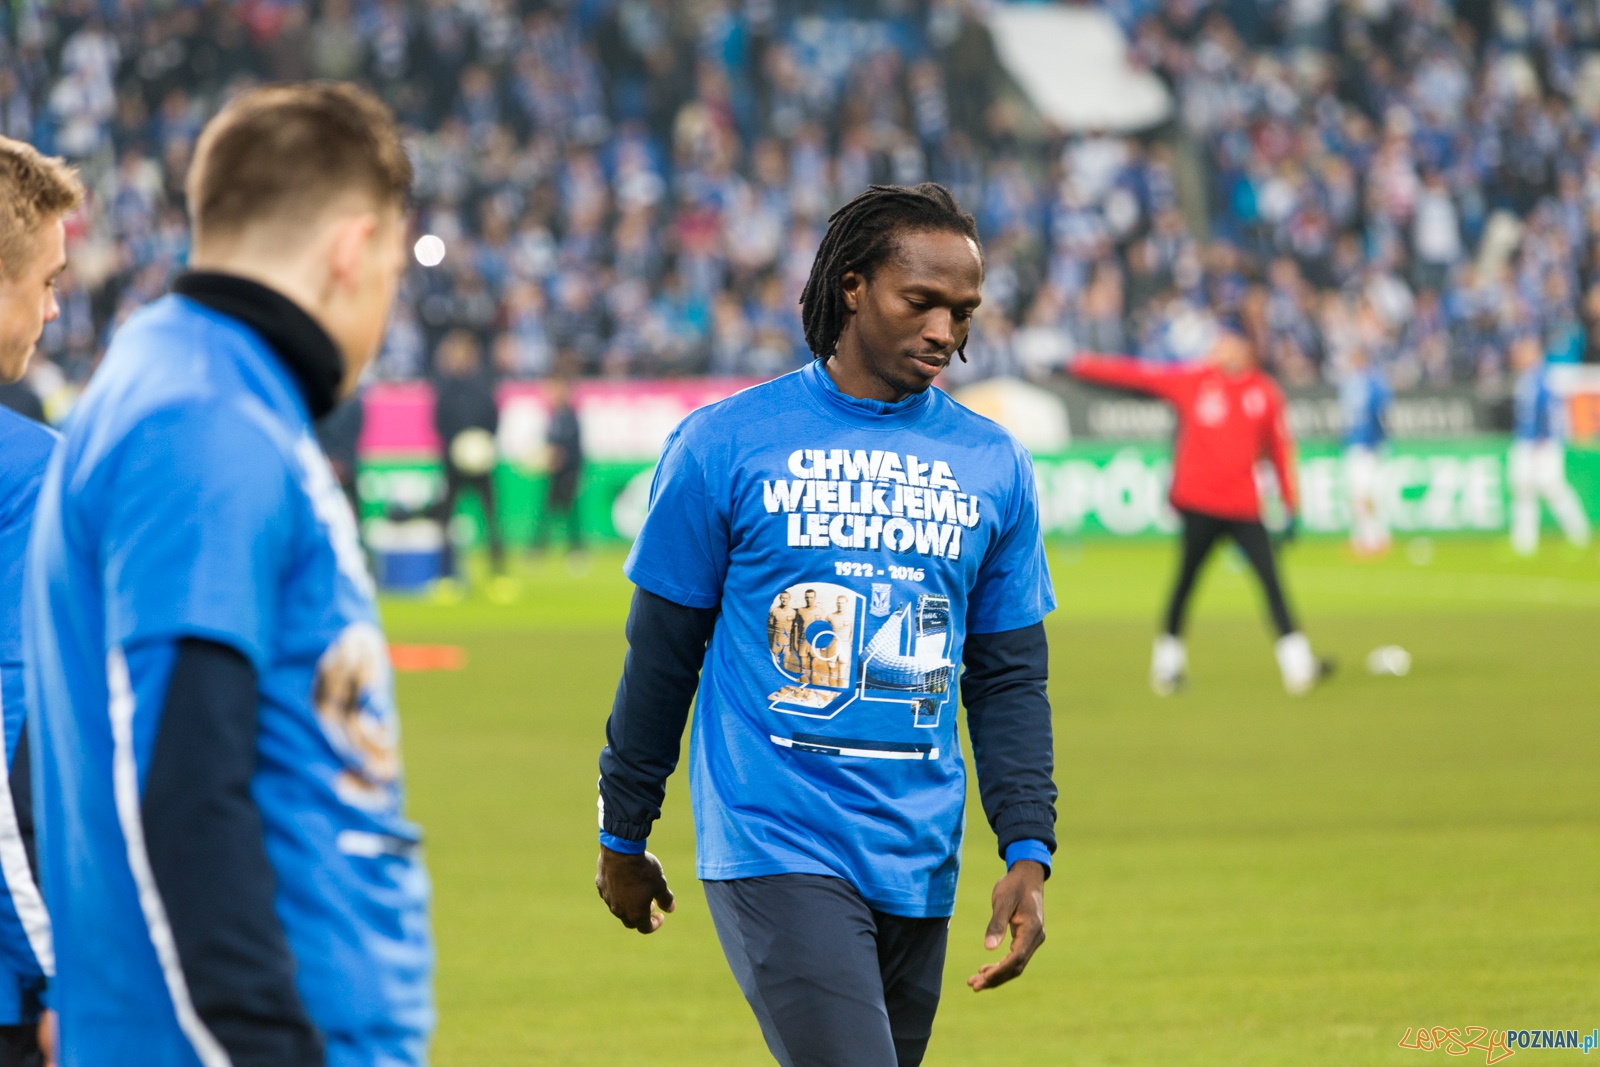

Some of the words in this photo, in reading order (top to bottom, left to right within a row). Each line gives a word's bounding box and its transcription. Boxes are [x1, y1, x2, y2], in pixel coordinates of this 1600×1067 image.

[788, 448, 961, 492] CHWAŁA
[763, 479, 980, 528] WIELKIEMU
[834, 561, 874, 578] 1922
[888, 565, 926, 582] 2016
